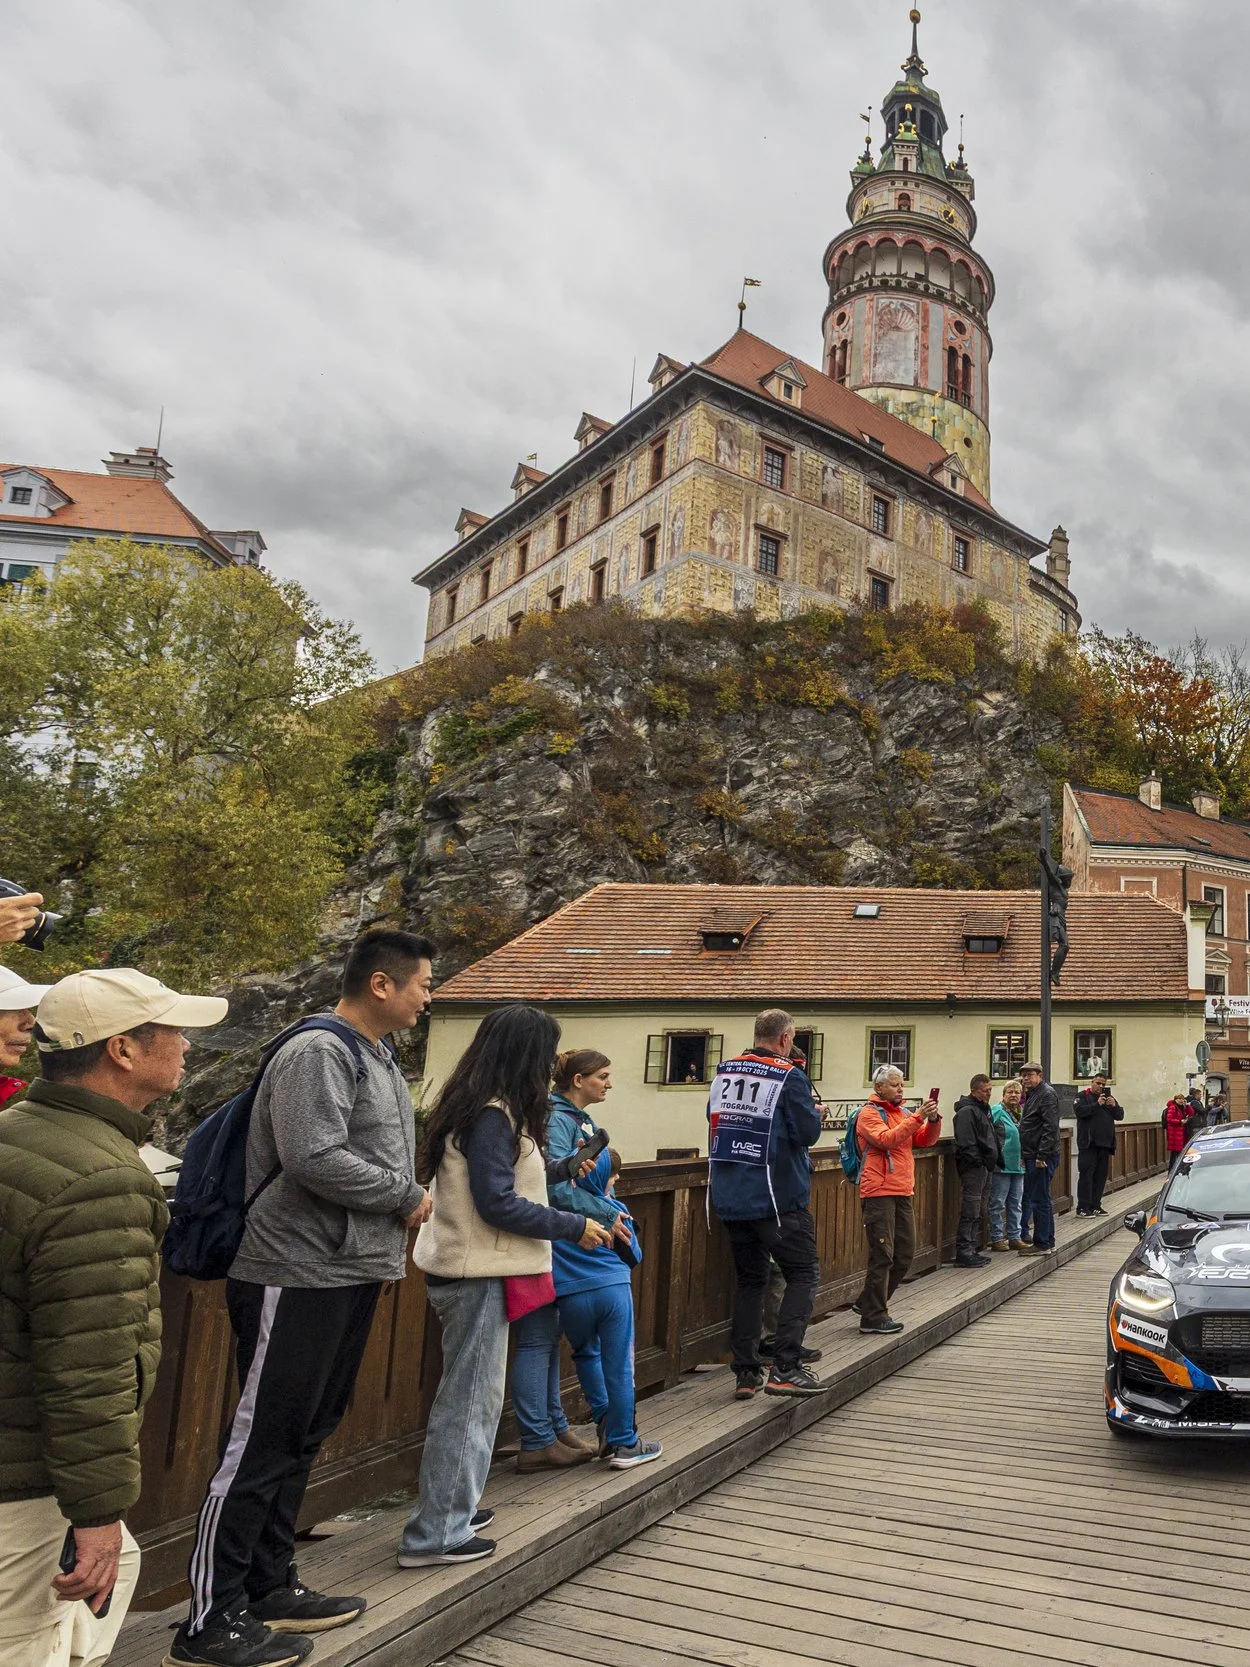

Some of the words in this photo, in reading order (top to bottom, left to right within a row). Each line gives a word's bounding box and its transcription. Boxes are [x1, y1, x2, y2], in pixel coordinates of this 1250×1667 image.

[742, 1060, 769, 1070] EUROPEAN
[769, 1066, 787, 1074] RALLY
[752, 1068, 768, 1076] 2025
[721, 1078, 761, 1103] 211
[720, 1102, 758, 1113] TOGRAPHER
[732, 1140, 762, 1153] WRC
